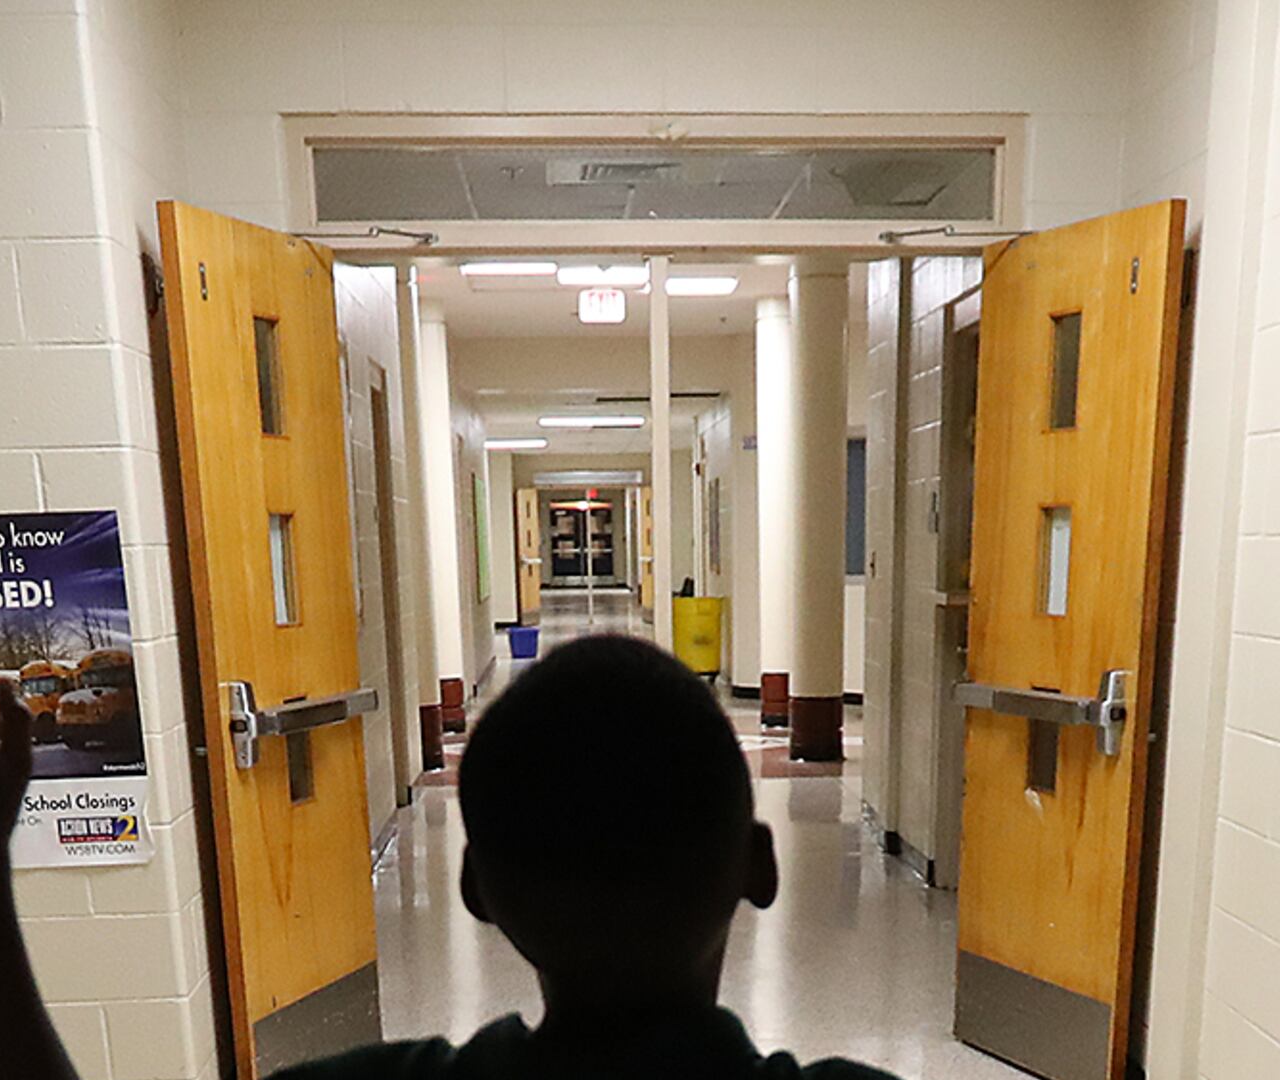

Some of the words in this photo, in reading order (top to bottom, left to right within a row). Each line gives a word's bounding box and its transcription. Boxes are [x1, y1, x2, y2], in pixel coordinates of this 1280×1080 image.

[10, 522, 64, 547] know
[8, 552, 25, 573] is
[24, 793, 72, 812] School
[75, 793, 136, 812] Closings
[116, 815, 139, 841] 2
